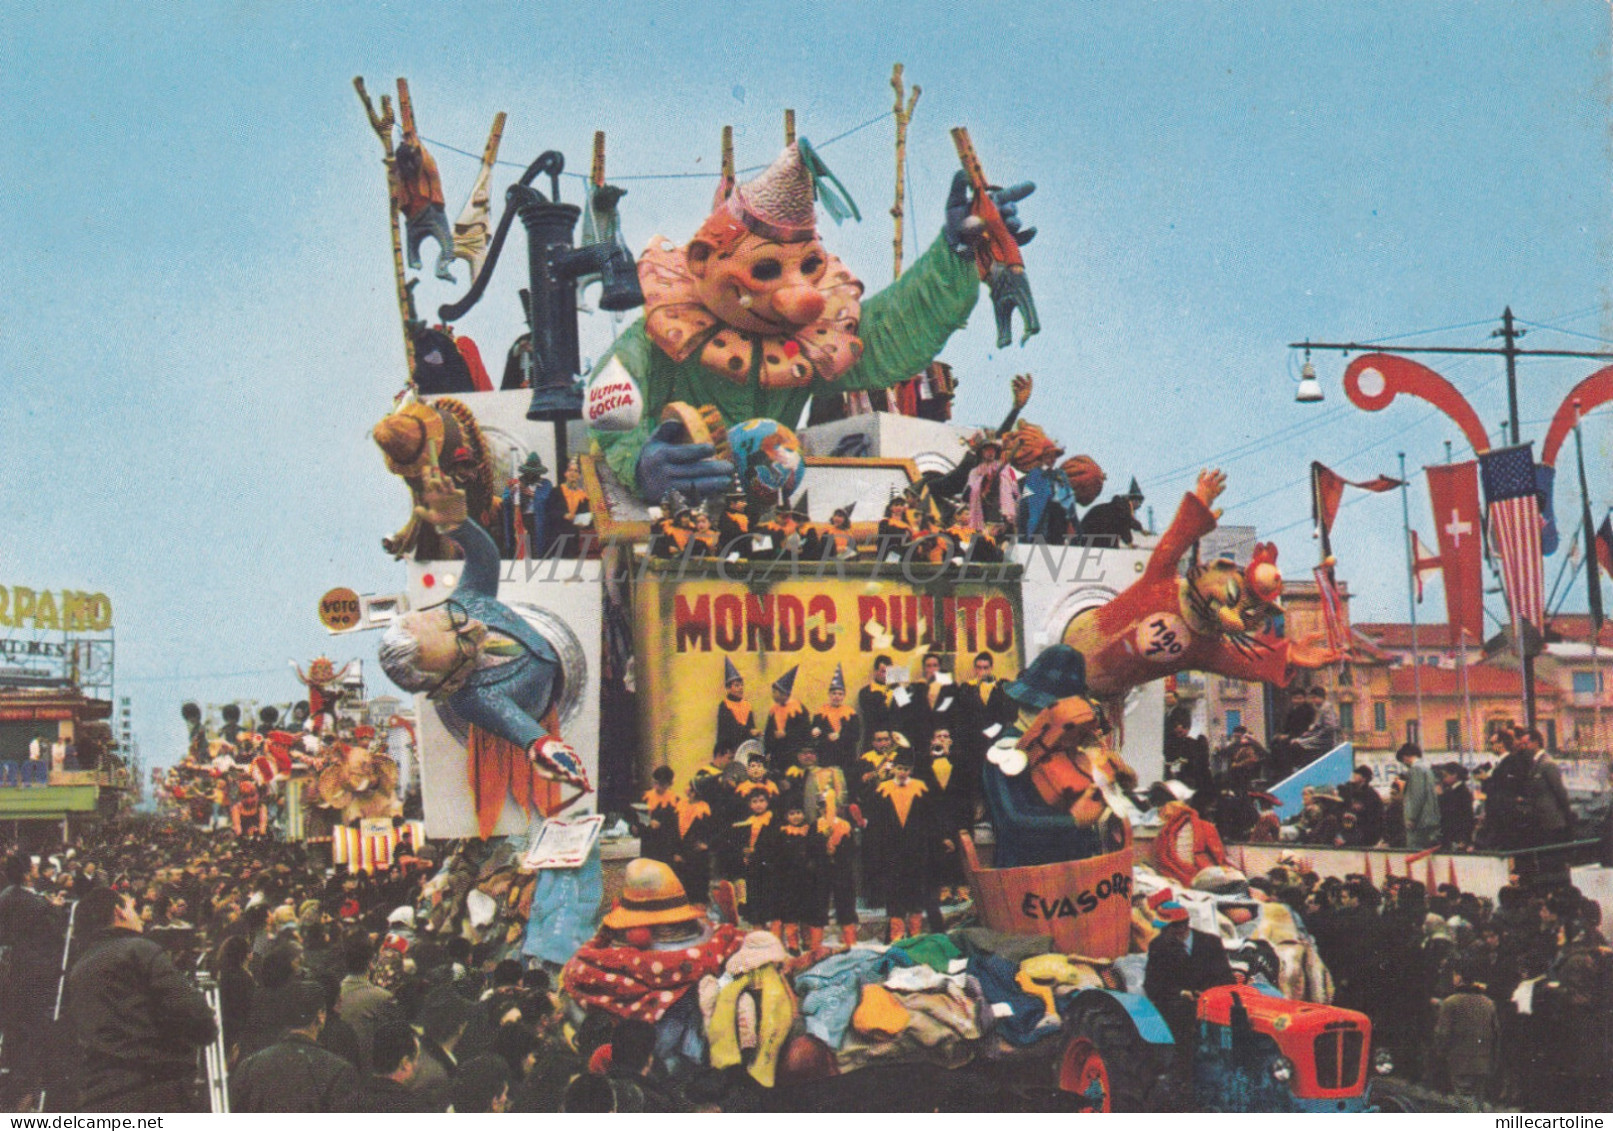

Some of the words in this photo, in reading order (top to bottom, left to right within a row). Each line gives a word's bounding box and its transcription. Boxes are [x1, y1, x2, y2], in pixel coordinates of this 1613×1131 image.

[590, 383, 632, 402] ULTIMA
[589, 394, 634, 420] GOCCIA
[323, 600, 357, 613] VOTO
[331, 616, 351, 625] NO
[674, 593, 837, 653] MONDO
[857, 594, 1014, 653] PULITO
[1149, 618, 1182, 655] MAO
